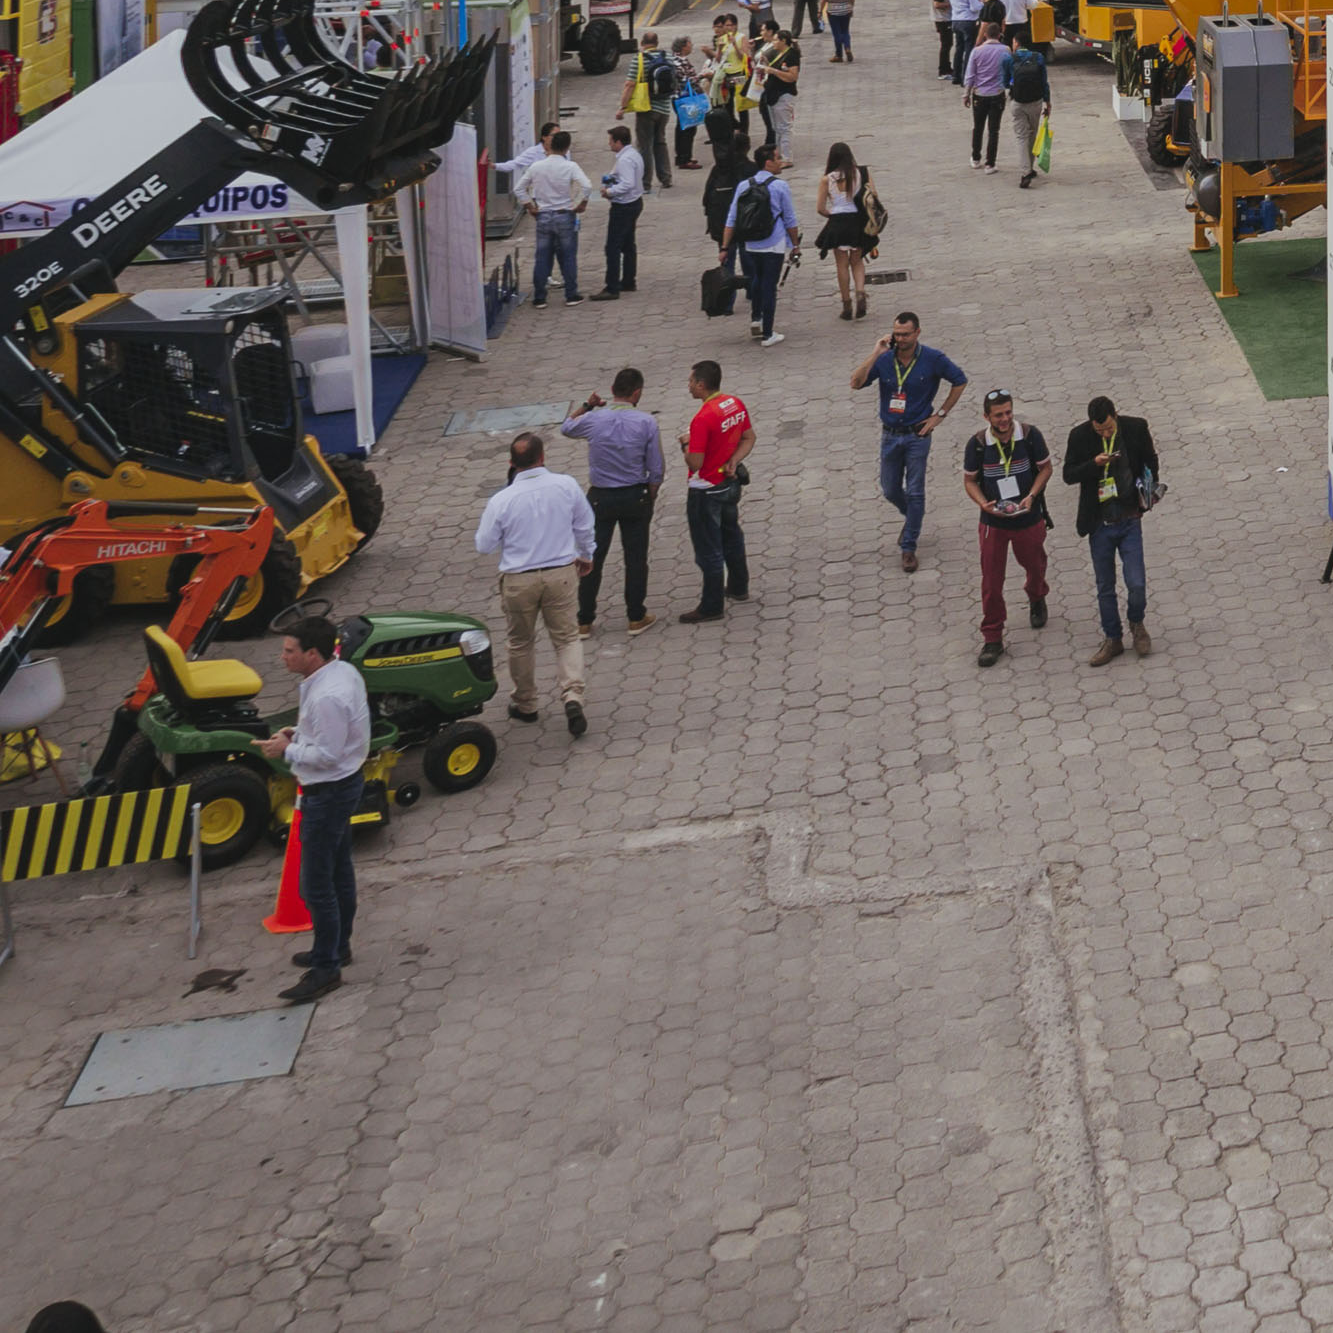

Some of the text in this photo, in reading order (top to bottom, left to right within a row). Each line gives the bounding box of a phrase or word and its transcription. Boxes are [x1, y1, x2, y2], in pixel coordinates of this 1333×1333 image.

[71, 174, 168, 248] DEERE
[188, 184, 289, 217] UIPOS
[14, 261, 64, 299] 320E
[720, 410, 747, 433] STAFF
[97, 541, 167, 559] HITACHI
